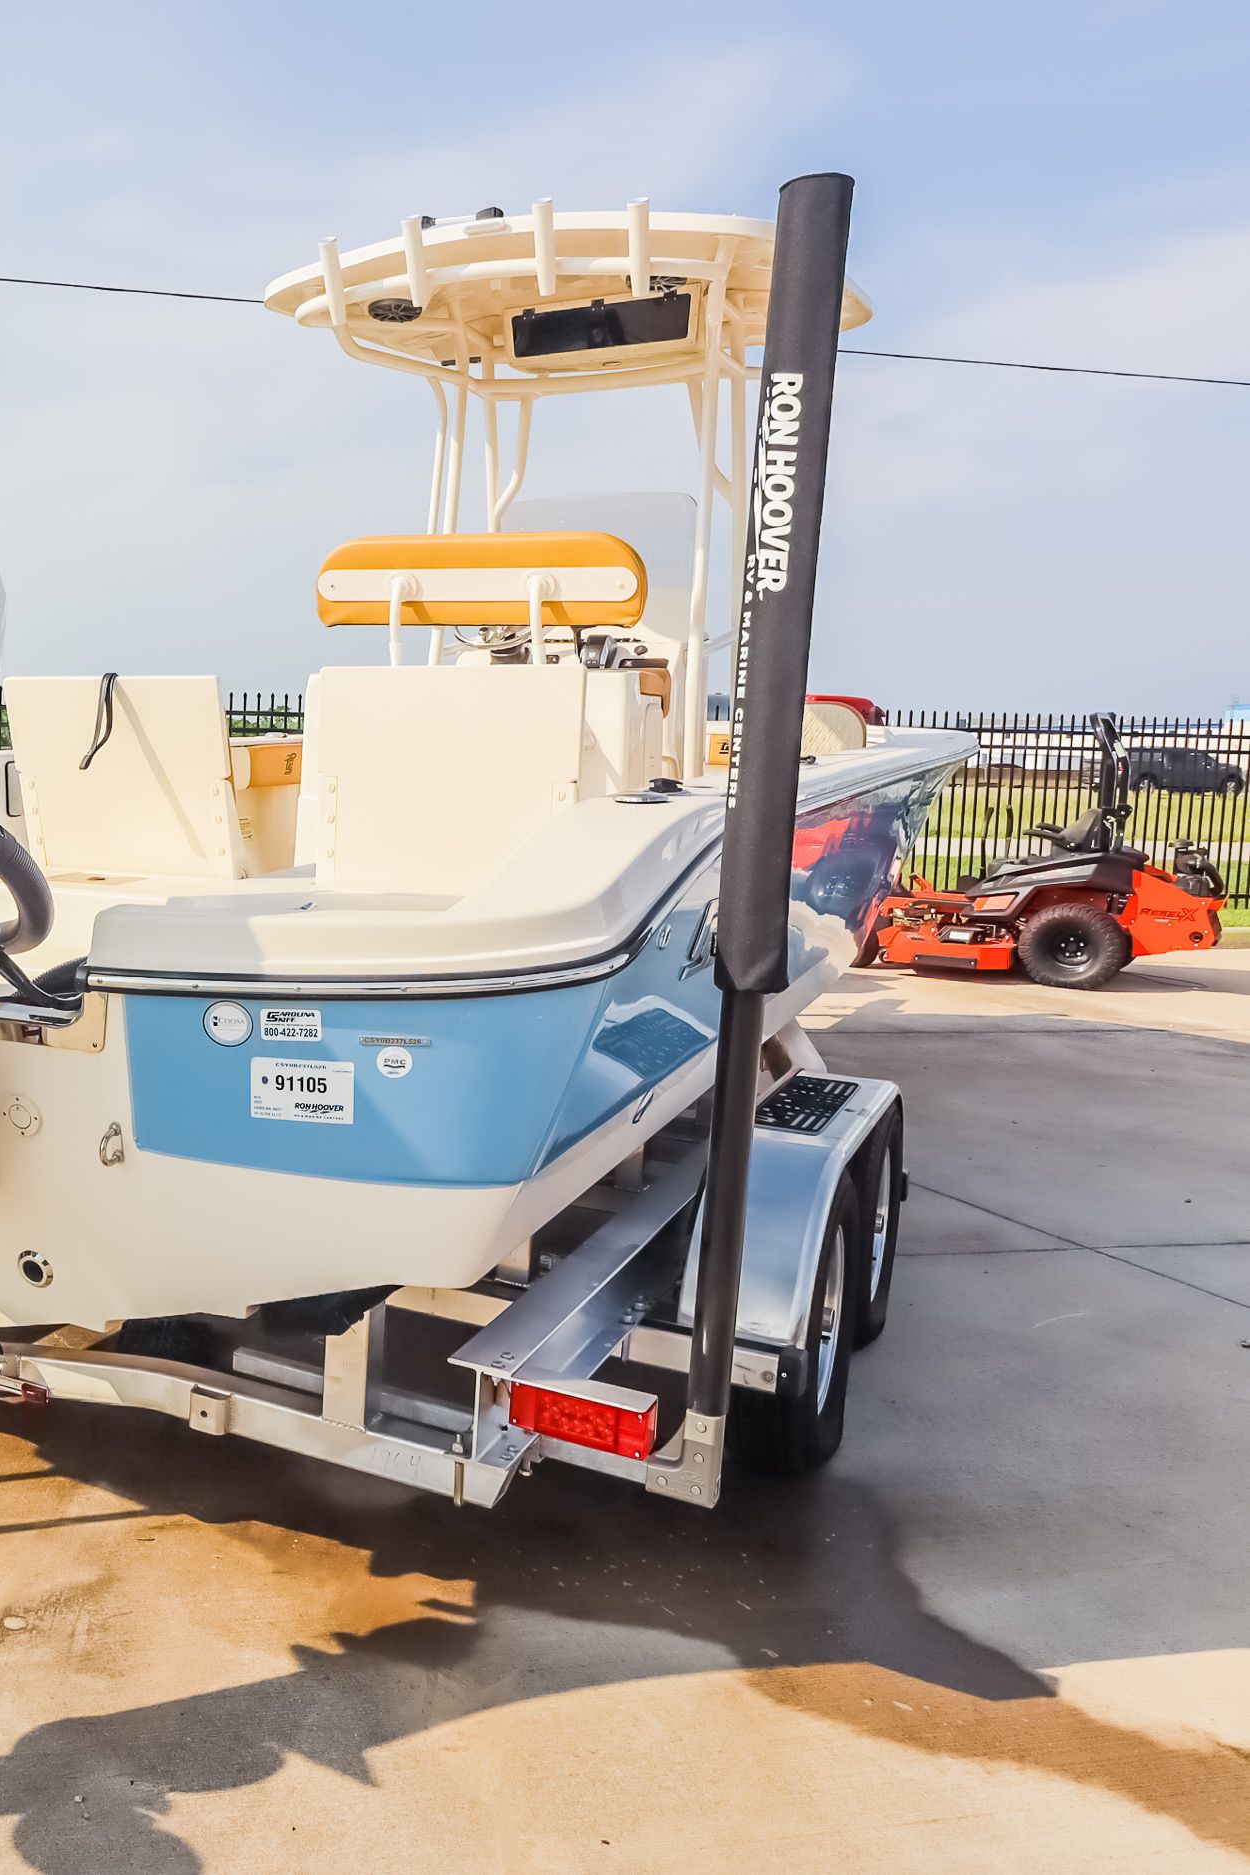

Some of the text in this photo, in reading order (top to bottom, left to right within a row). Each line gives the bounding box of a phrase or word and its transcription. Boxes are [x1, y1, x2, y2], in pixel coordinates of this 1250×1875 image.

[756, 372, 803, 594] RON HOOVER
[728, 554, 757, 809] RV & MARINE CENTERS
[266, 1014, 295, 1022] SKIFF
[267, 1011, 315, 1019] CAROLINA
[264, 1027, 318, 1038] 800-422-7282
[275, 1074, 327, 1094] 91105
[294, 1102, 344, 1112] RON HOOVER
